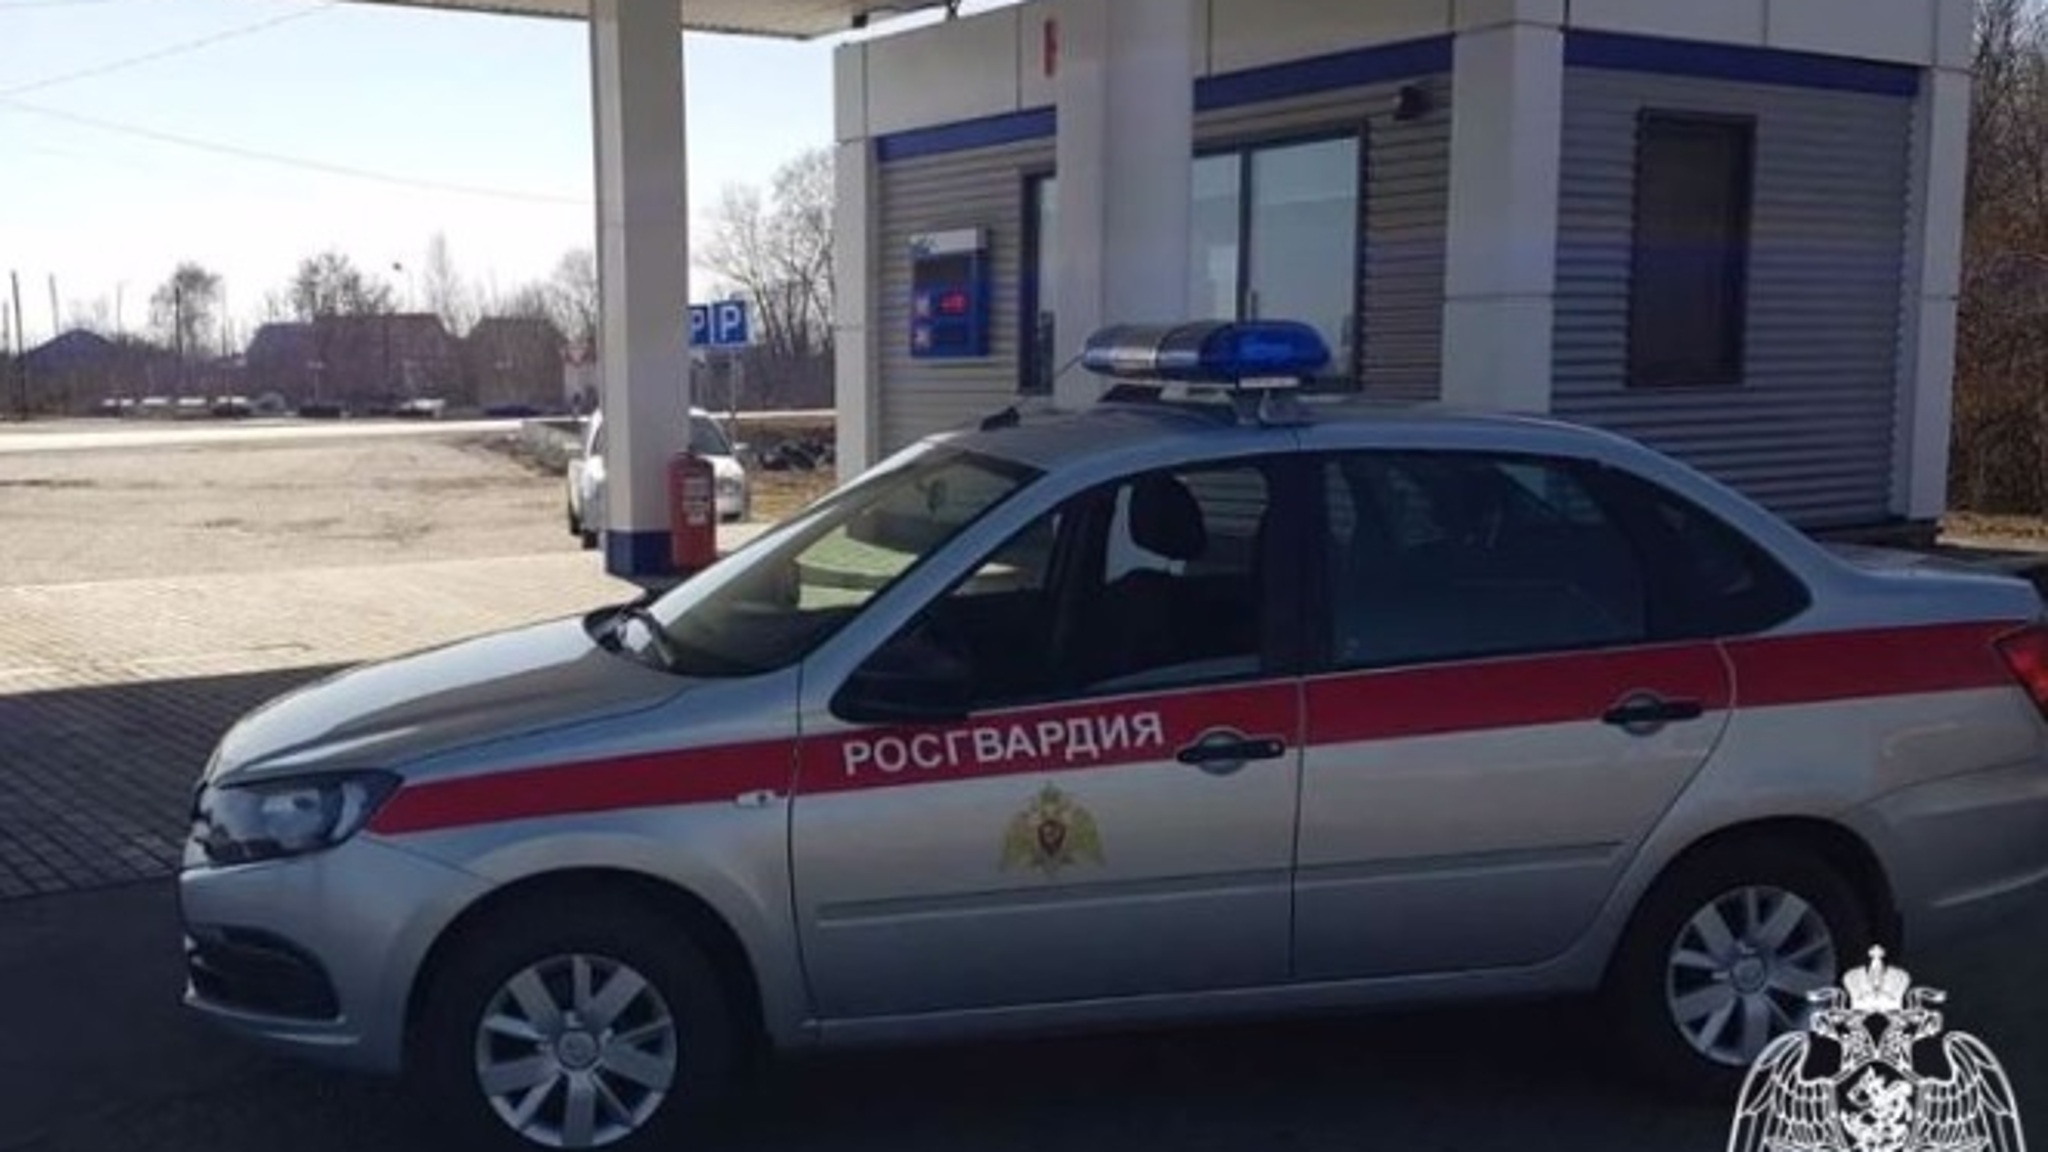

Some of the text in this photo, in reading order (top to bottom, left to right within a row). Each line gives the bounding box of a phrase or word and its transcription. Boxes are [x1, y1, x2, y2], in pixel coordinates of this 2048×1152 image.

[690, 308, 705, 342] P
[721, 305, 741, 341] P
[843, 711, 1164, 775] РОСГВАРДИЯ
